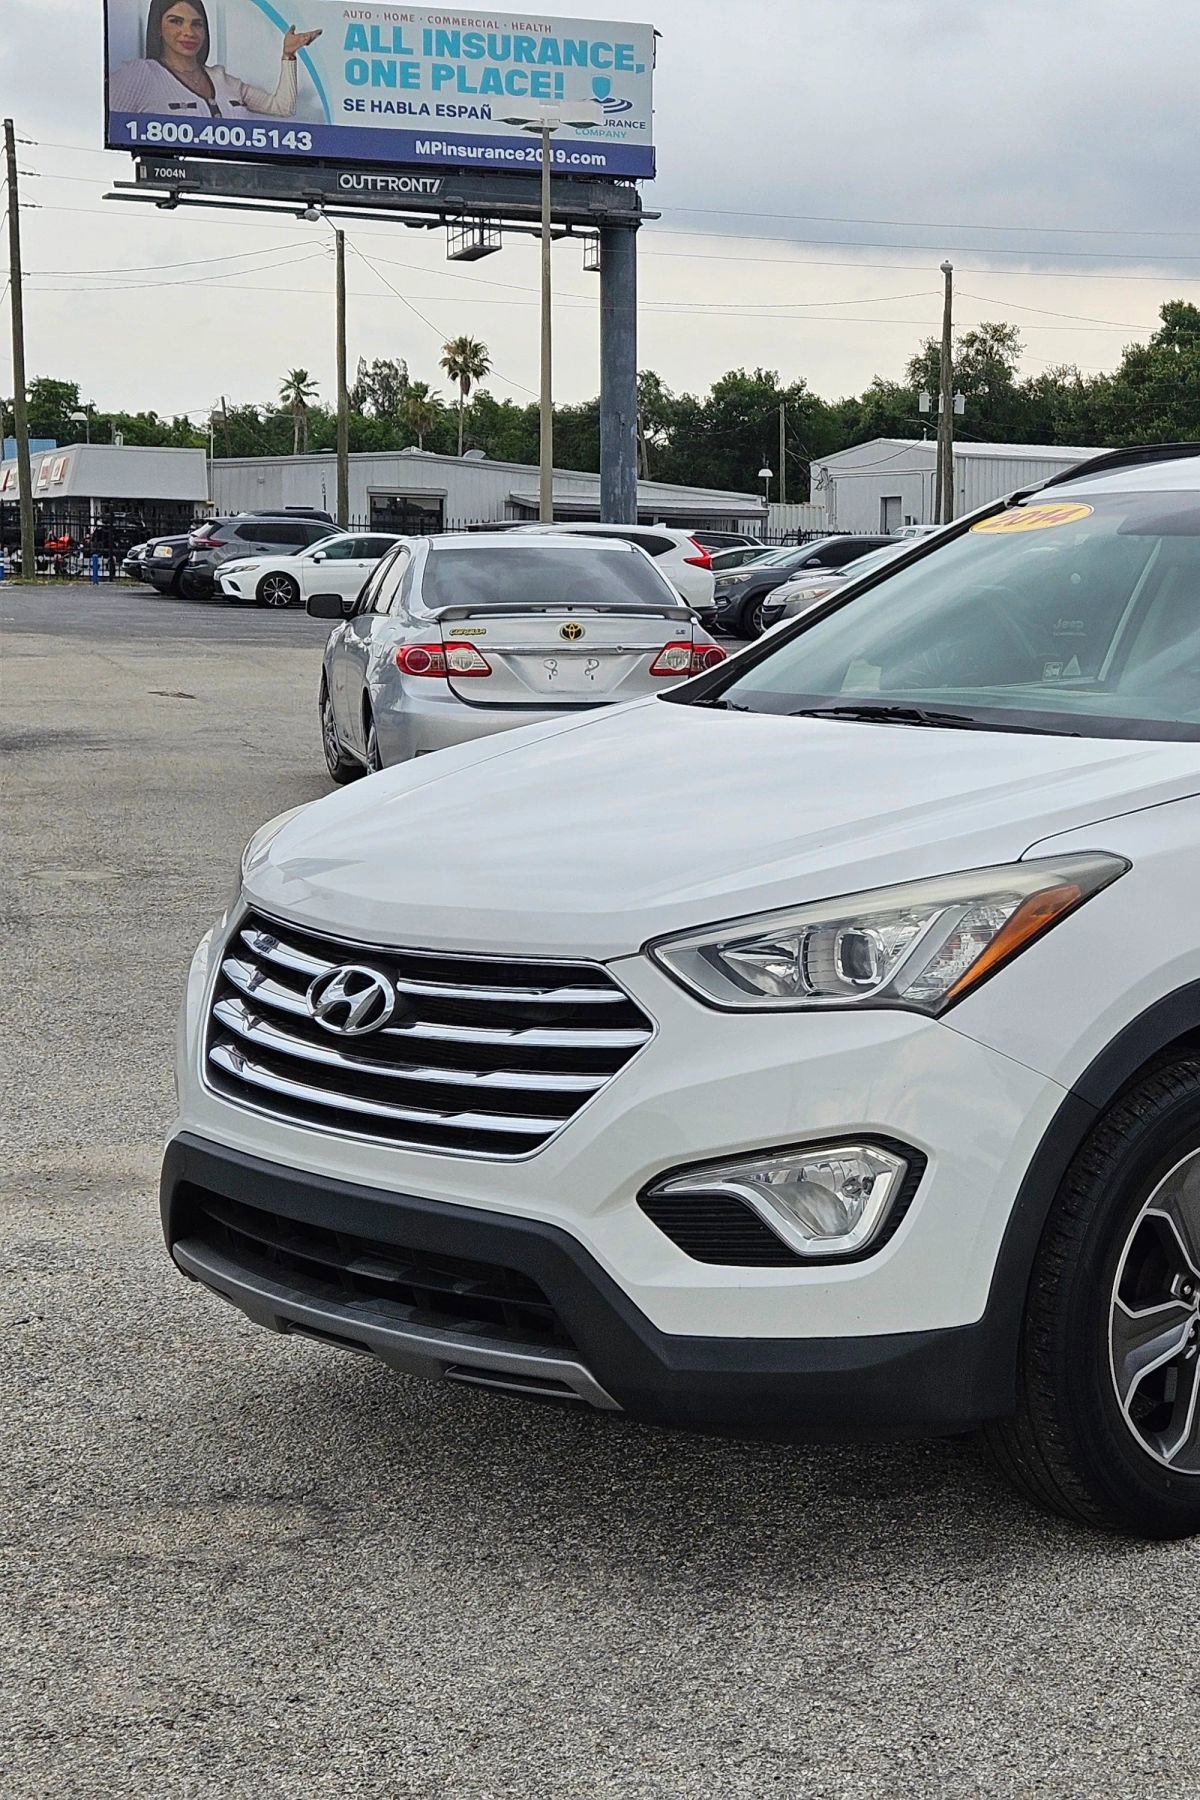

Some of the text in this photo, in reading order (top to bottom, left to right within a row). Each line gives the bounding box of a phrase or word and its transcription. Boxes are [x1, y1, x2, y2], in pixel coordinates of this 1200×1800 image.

[343, 10, 551, 33] AUTO HOME COMMERCIAL HEALTH
[344, 23, 645, 74] ALL INSURANCE,
[344, 58, 564, 100] ONE PLACE!
[343, 98, 492, 120] SE HABLA ESPAÑ
[125, 121, 313, 150] 1.800.400.5143
[575, 128, 626, 138] COMPANY
[603, 119, 646, 129] URANCE
[154, 167, 186, 178] 7004N
[979, 507, 1085, 530] 2014
